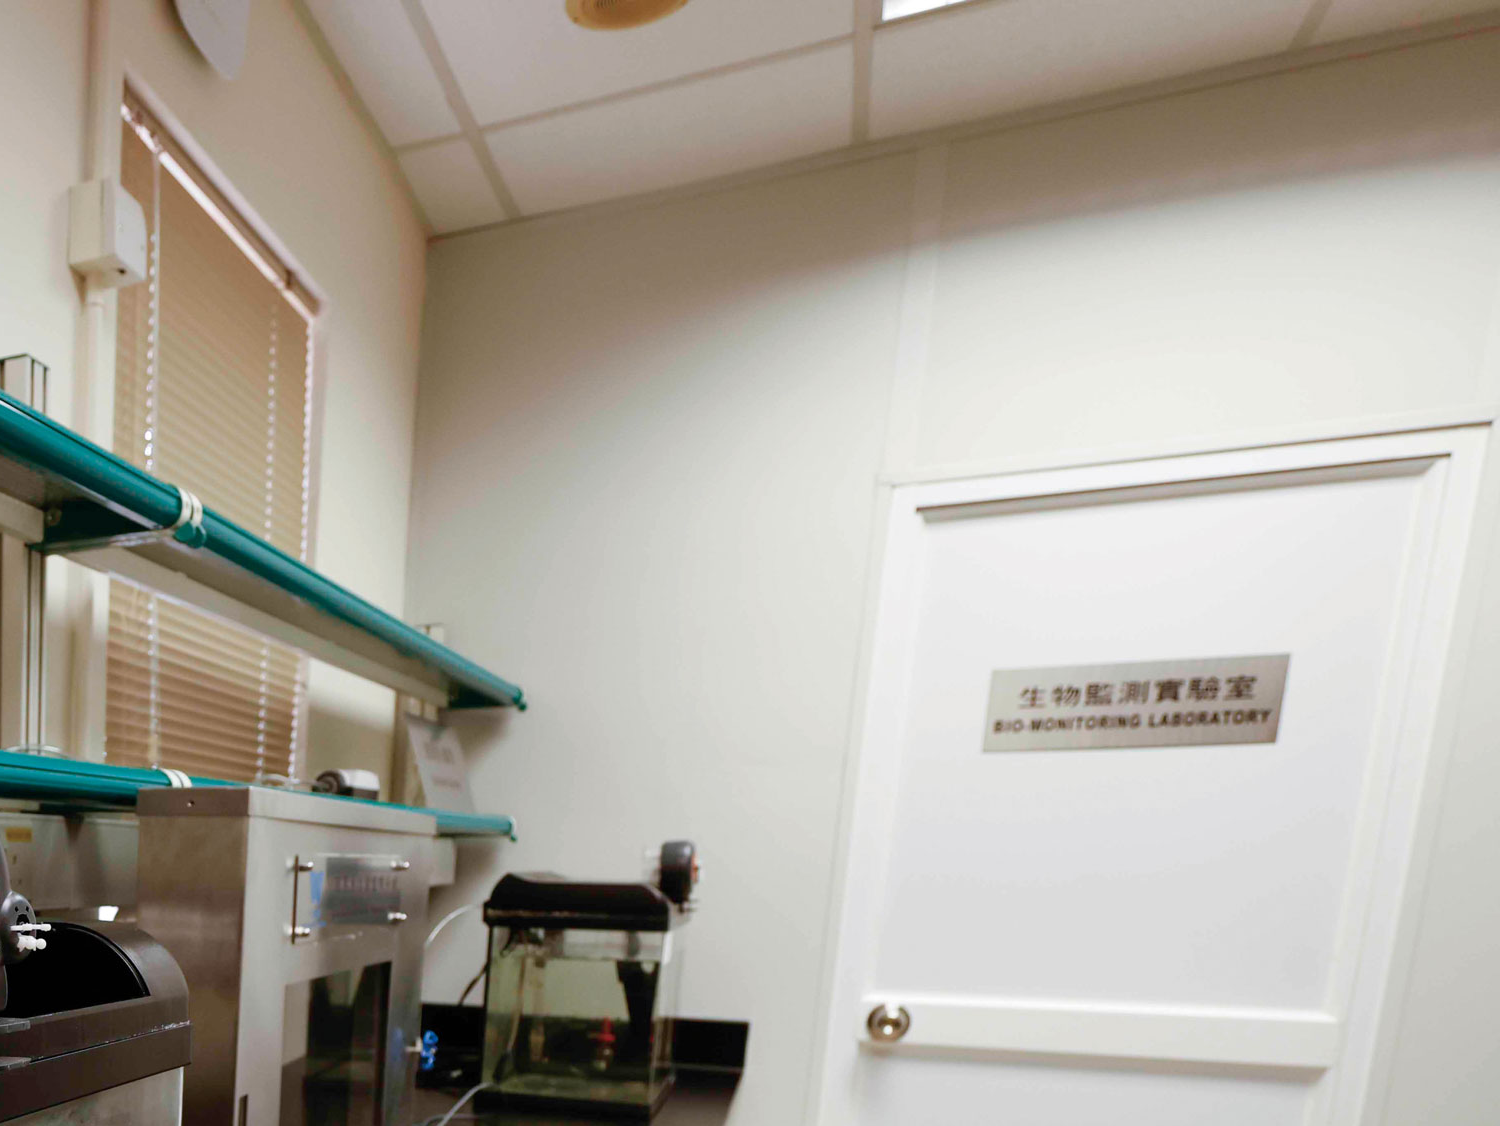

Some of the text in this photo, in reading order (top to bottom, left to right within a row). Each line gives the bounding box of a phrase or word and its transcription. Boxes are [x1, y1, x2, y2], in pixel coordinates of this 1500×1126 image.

[1017, 674, 1258, 709] 生物監測實驗室
[1148, 708, 1272, 728] LABORATORY
